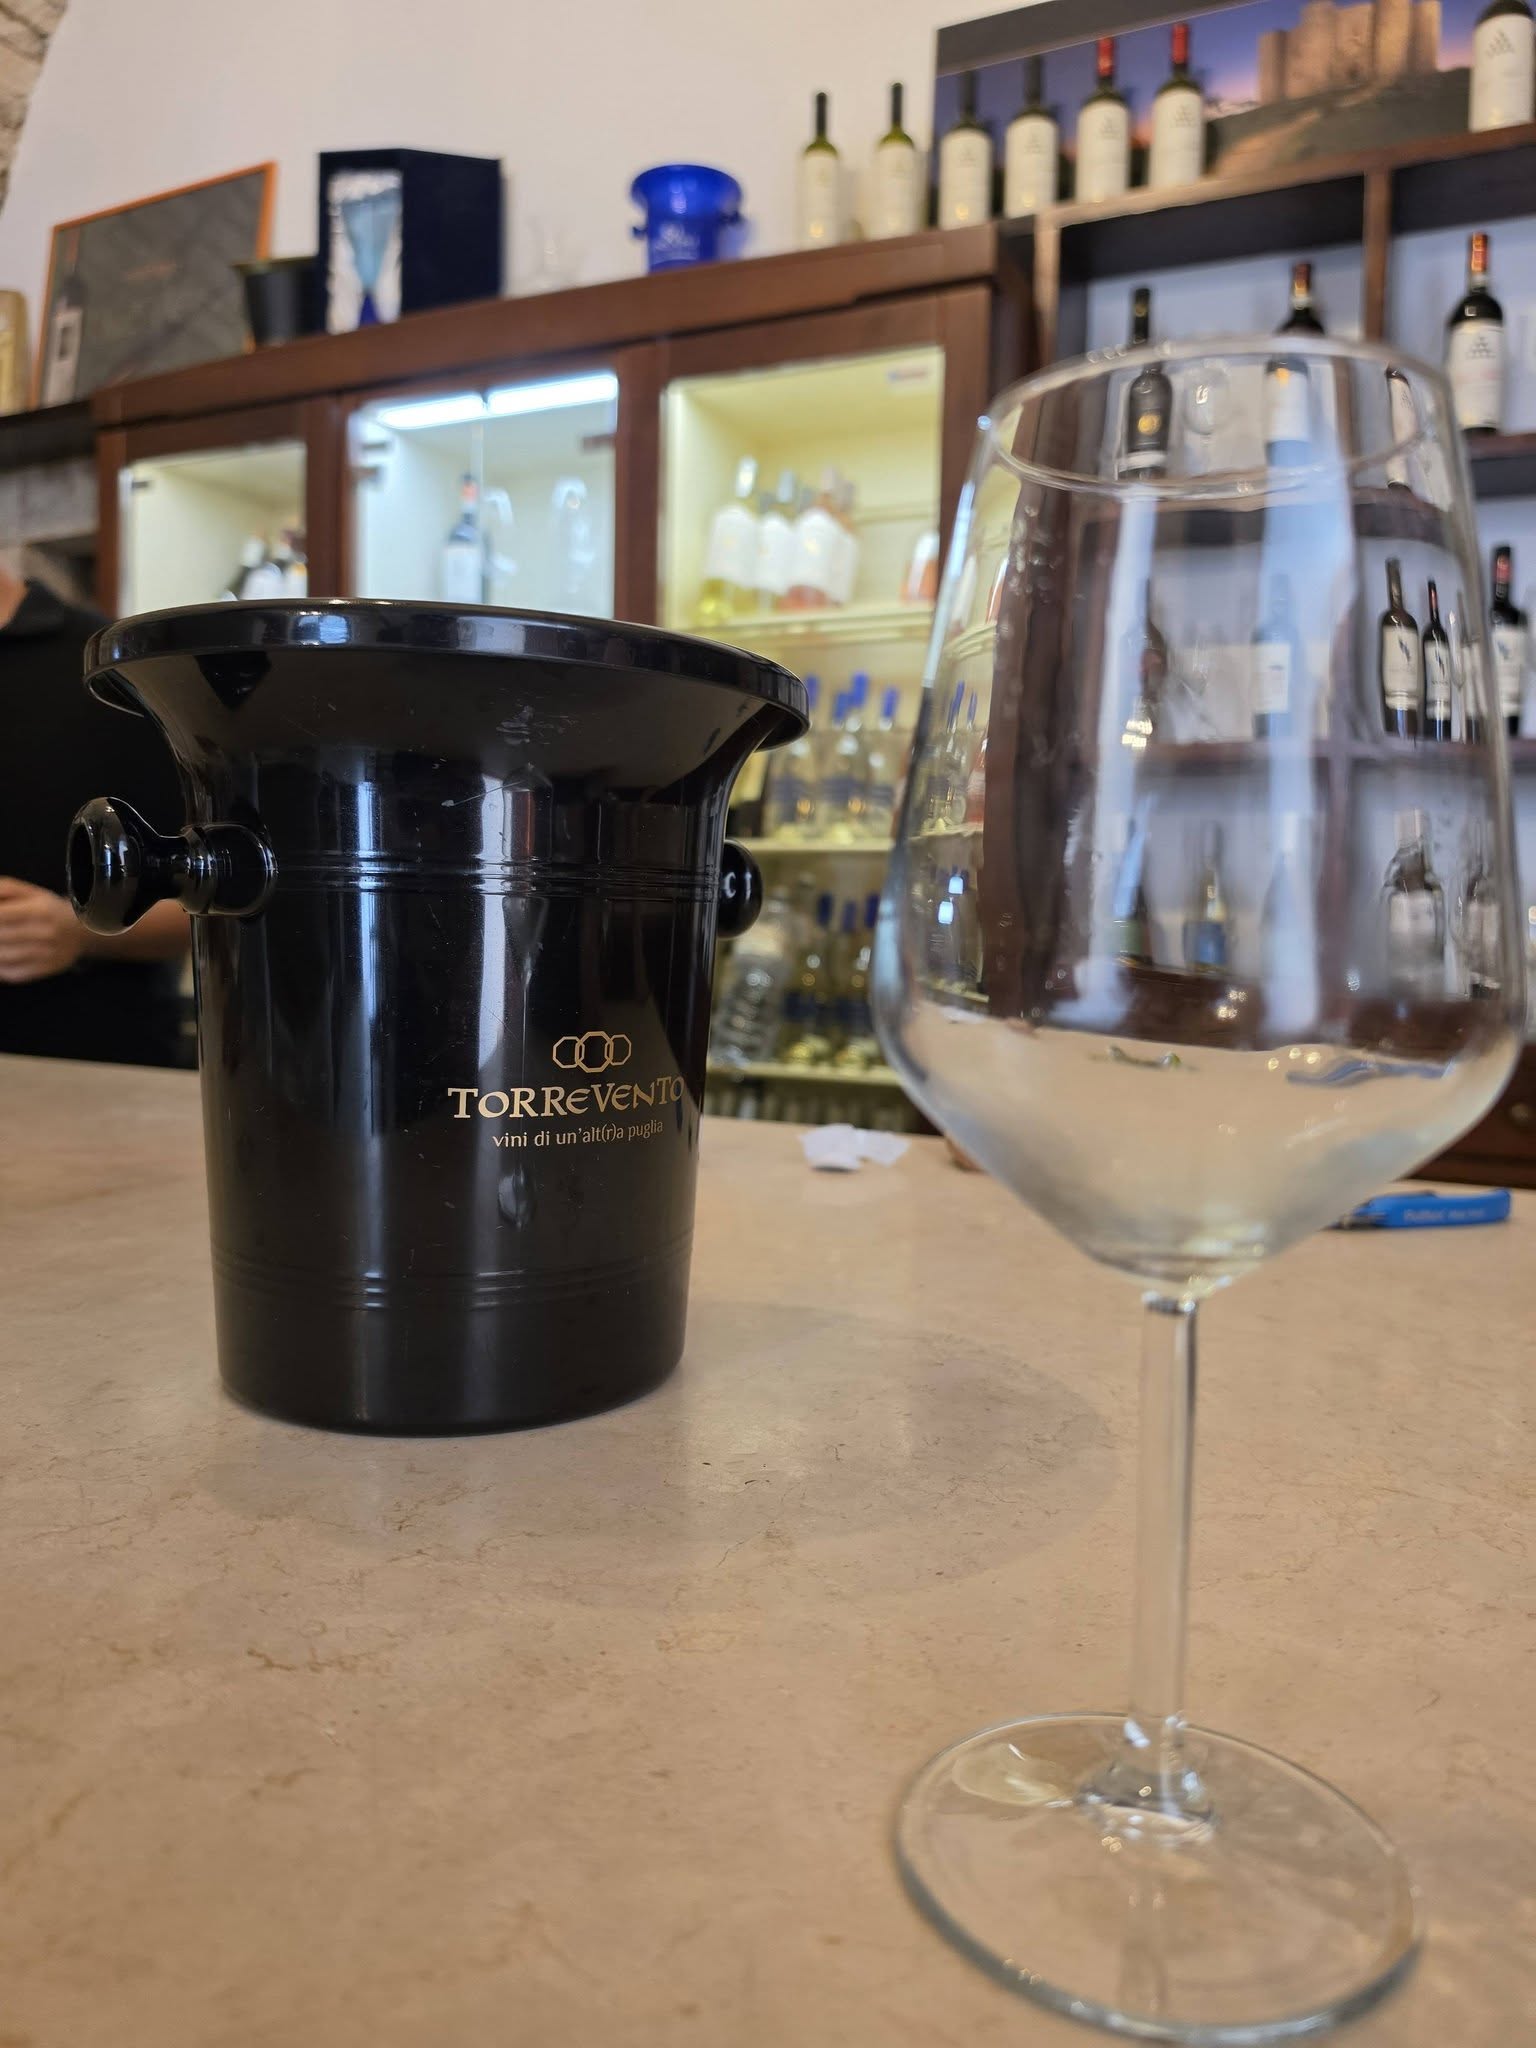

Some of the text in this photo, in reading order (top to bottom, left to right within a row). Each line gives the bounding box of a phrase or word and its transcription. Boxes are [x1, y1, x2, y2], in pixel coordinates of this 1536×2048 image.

[448, 1076, 685, 1119] TORREVENTO
[492, 1132, 528, 1148] vini
[534, 1130, 550, 1147] di
[628, 1119, 664, 1139] puglia
